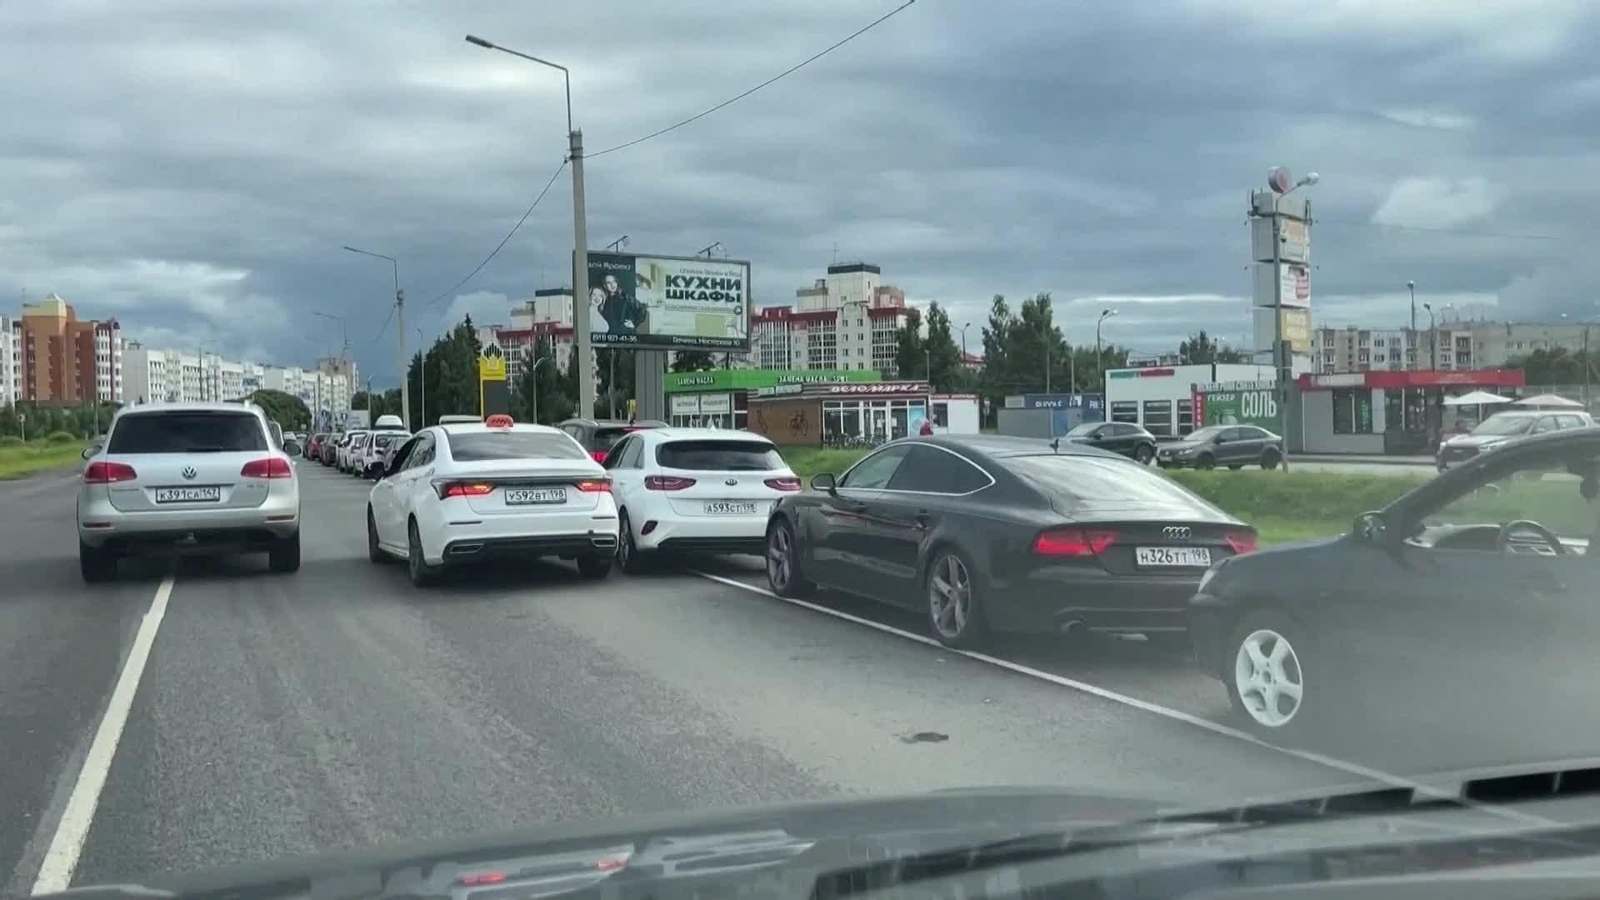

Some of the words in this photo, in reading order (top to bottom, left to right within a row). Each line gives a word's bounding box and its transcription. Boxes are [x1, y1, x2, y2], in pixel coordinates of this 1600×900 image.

[666, 275, 741, 291] КУХНИ
[666, 289, 741, 303] ШКАФЫ
[831, 384, 920, 393] ВЕЛОМАРКА
[1241, 391, 1277, 418] СОЛЬ
